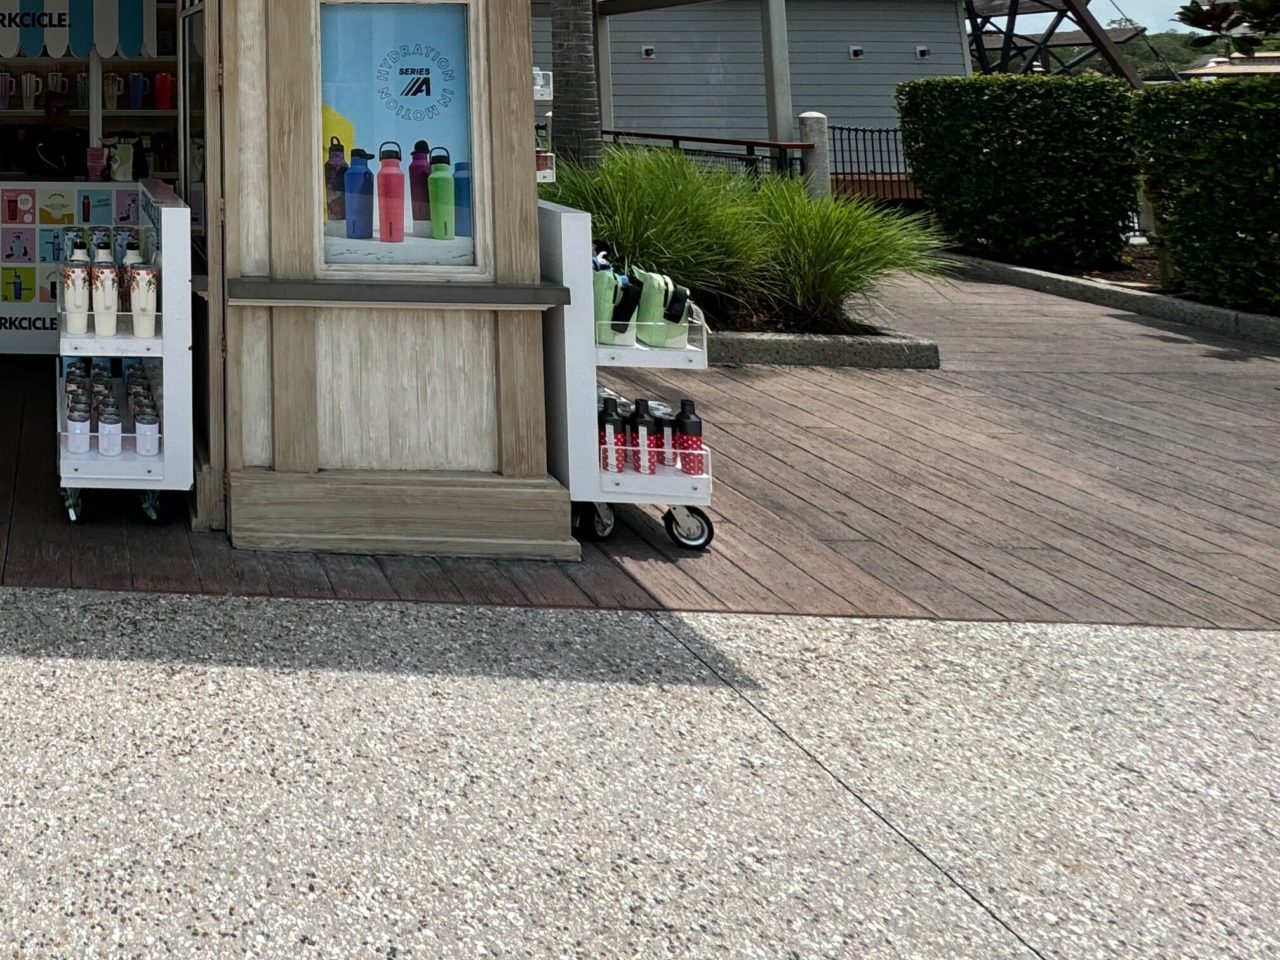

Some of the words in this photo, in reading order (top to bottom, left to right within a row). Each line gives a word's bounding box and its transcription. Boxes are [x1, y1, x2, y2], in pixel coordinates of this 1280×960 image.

[376, 43, 455, 82] HYDRATION
[399, 68, 430, 76] SERIES
[377, 86, 440, 121] MOTION
